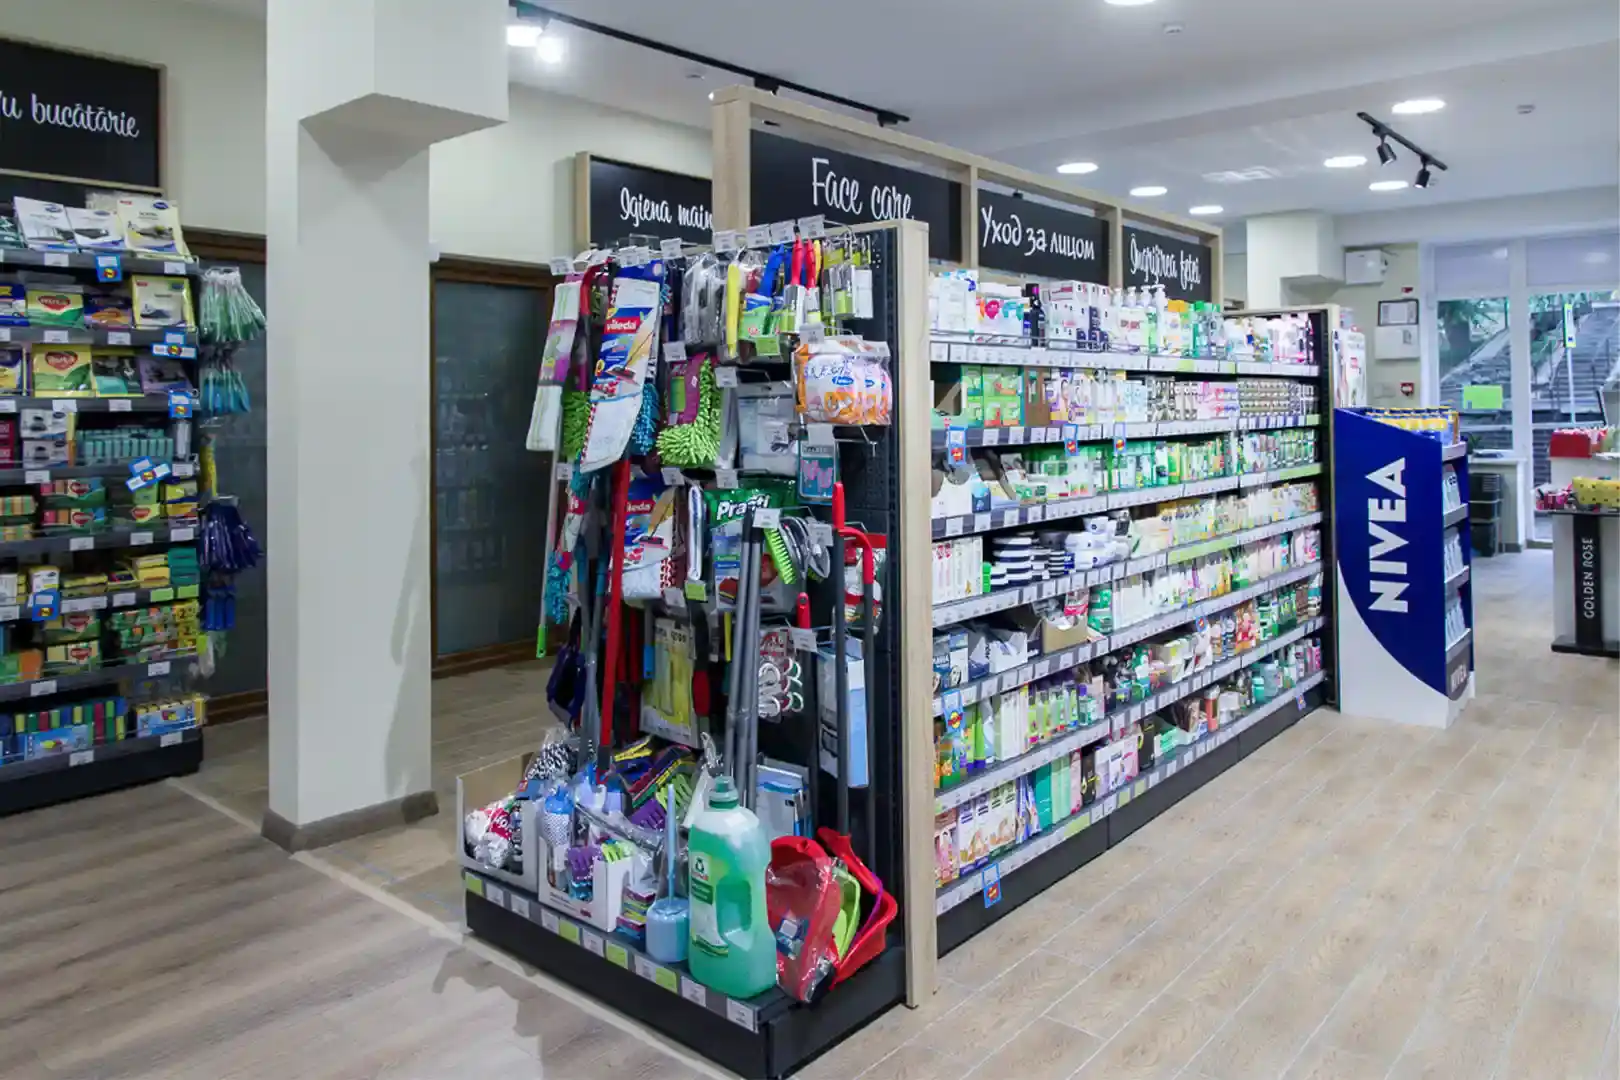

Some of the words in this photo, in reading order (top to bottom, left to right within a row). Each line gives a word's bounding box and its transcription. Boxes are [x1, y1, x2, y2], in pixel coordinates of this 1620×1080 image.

[31, 93, 140, 138] bucătărie
[620, 187, 673, 228] Igiena
[812, 157, 863, 215] Face
[870, 185, 915, 220] care
[981, 205, 1022, 248] Уход
[1024, 227, 1048, 257] за
[1049, 231, 1095, 260] лицом
[1365, 457, 1410, 613] NIVEA
[1582, 537, 1595, 568] ROSE
[1583, 571, 1596, 619] GOLDEN
